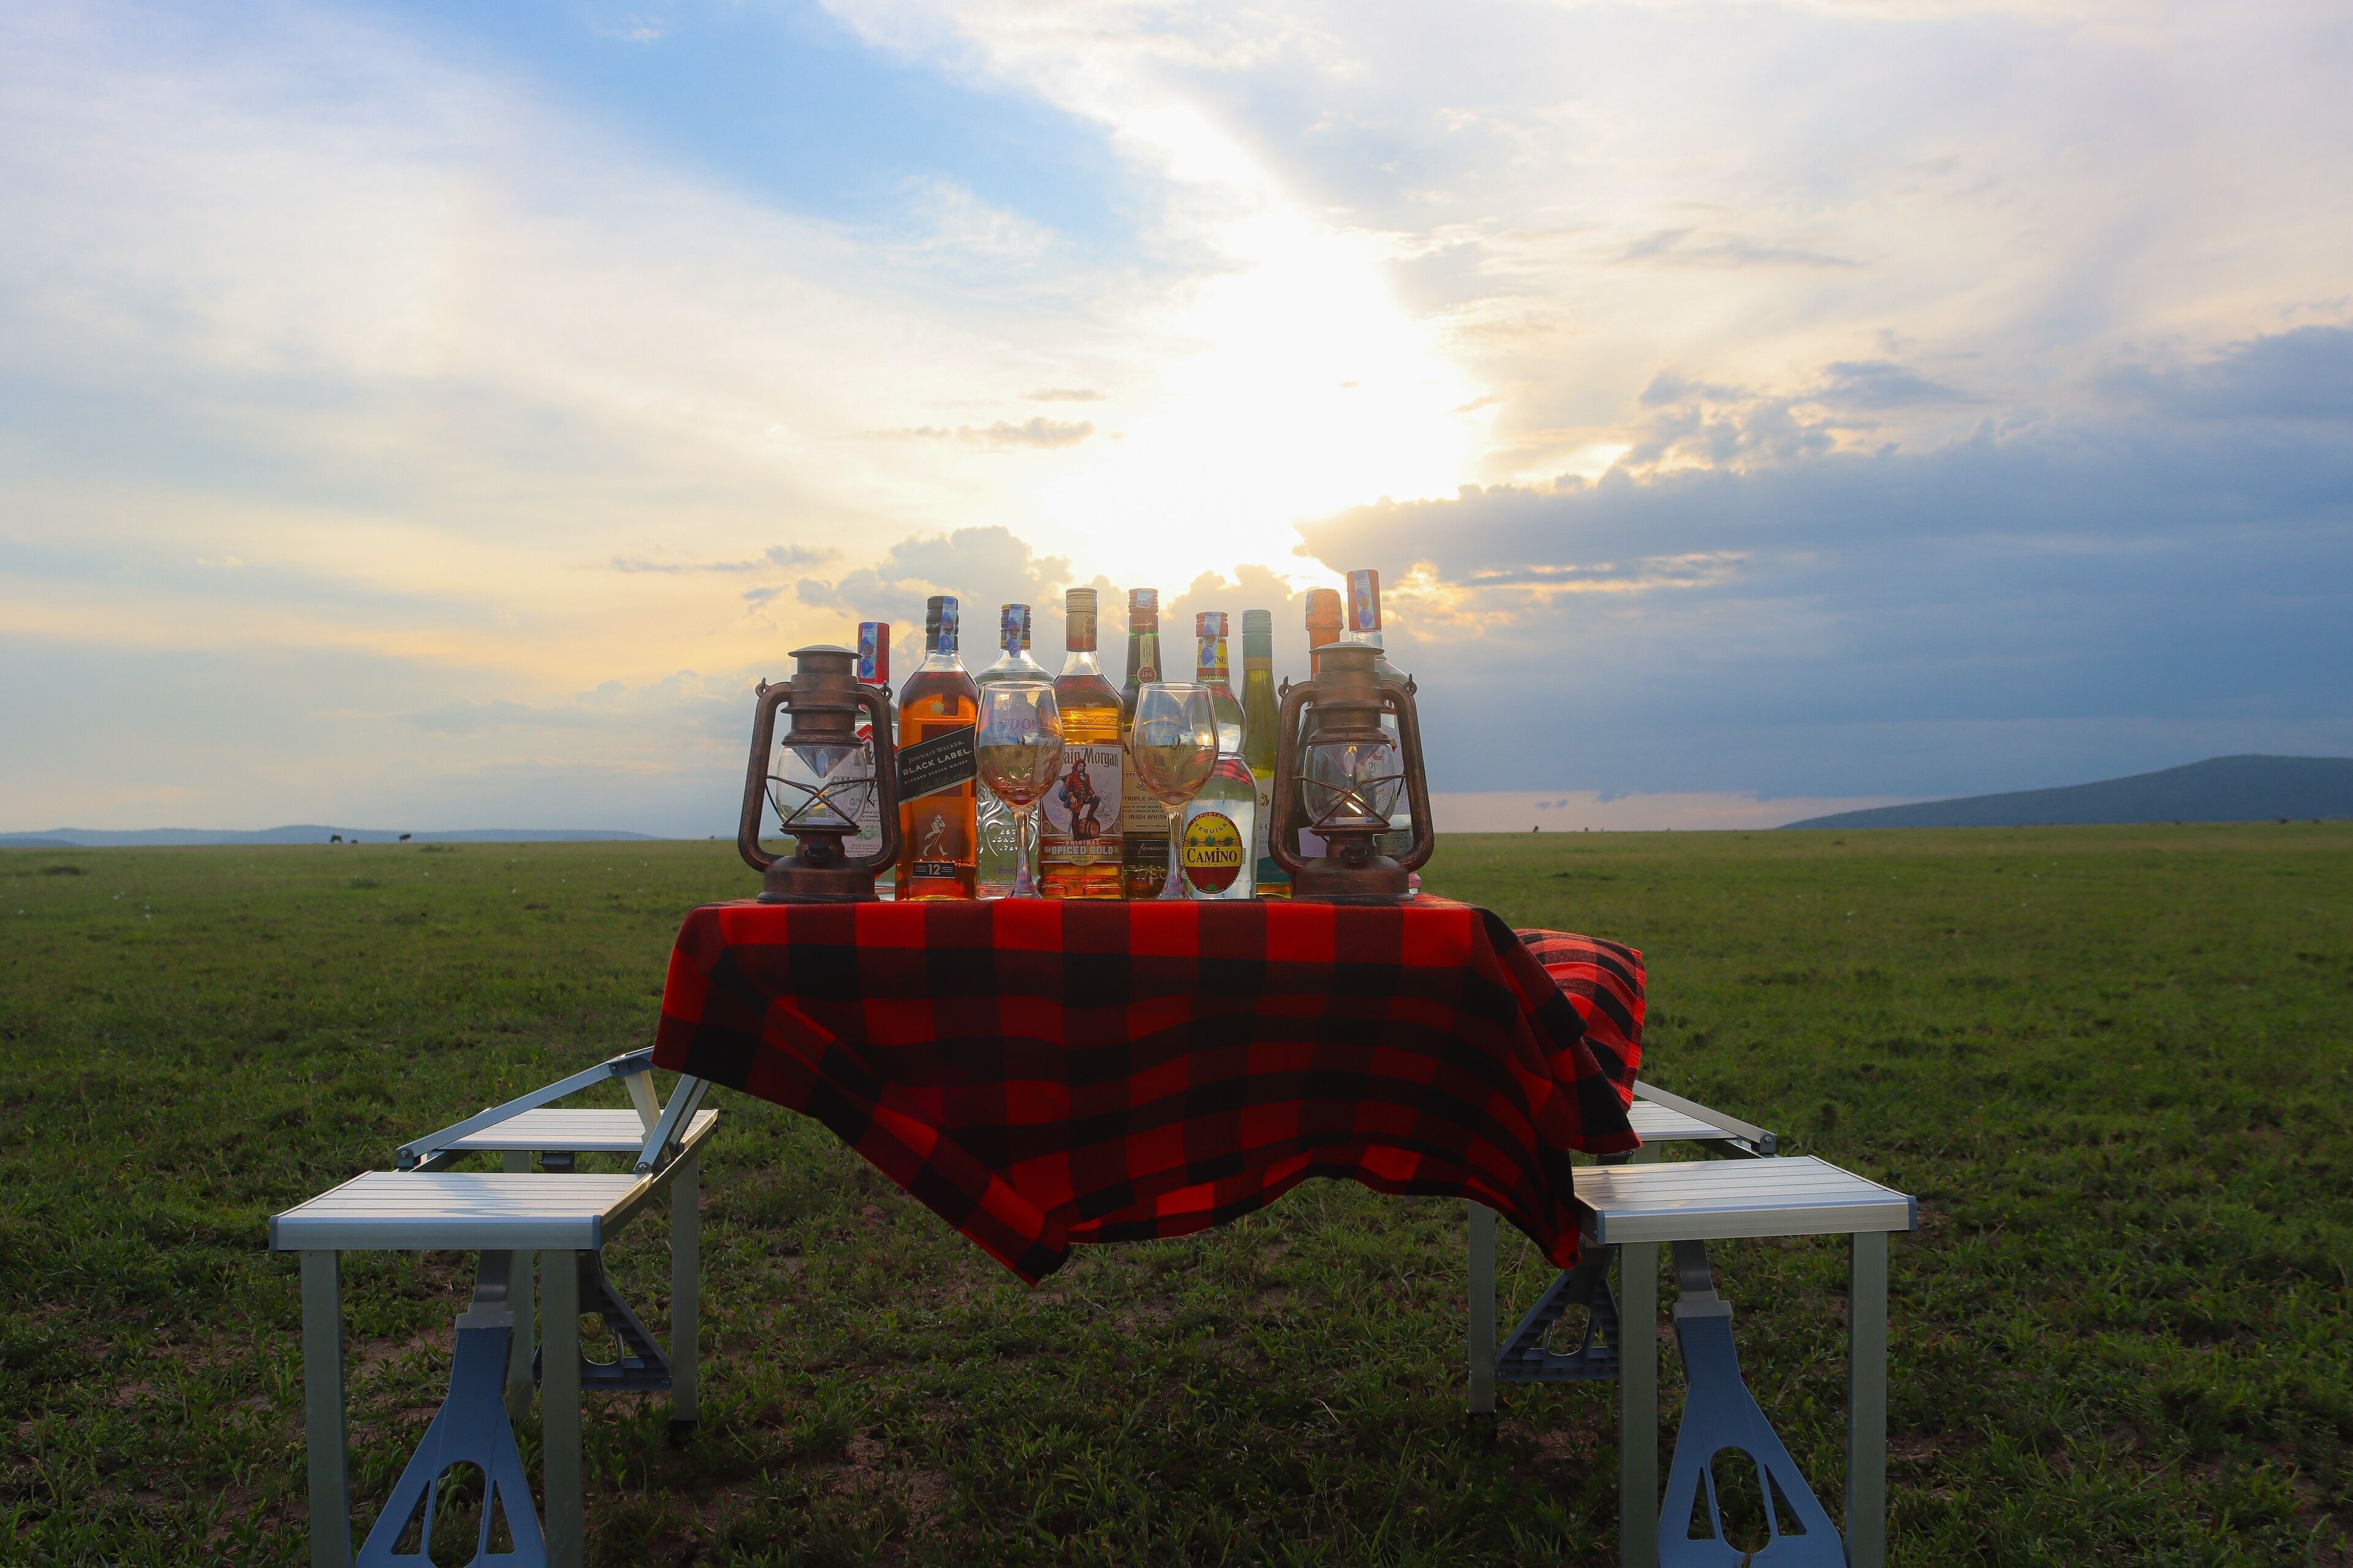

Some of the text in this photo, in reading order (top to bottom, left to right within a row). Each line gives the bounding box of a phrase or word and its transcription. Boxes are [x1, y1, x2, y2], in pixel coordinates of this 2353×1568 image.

[907, 750, 936, 765] JOHNNIE
[1082, 747, 1118, 768] Morgan
[902, 759, 936, 776] BLACK
[904, 774, 926, 784] BLENDED
[928, 767, 947, 776] SCOTCH
[949, 759, 968, 768] WHISKY
[1192, 812, 1230, 822] IMPORTADO
[1195, 822, 1227, 833] TEQUILA
[1051, 846, 1087, 855] SPICED
[1089, 846, 1113, 855] GOLD
[1187, 847, 1237, 863] CAMINO
[928, 864, 941, 875] 12
